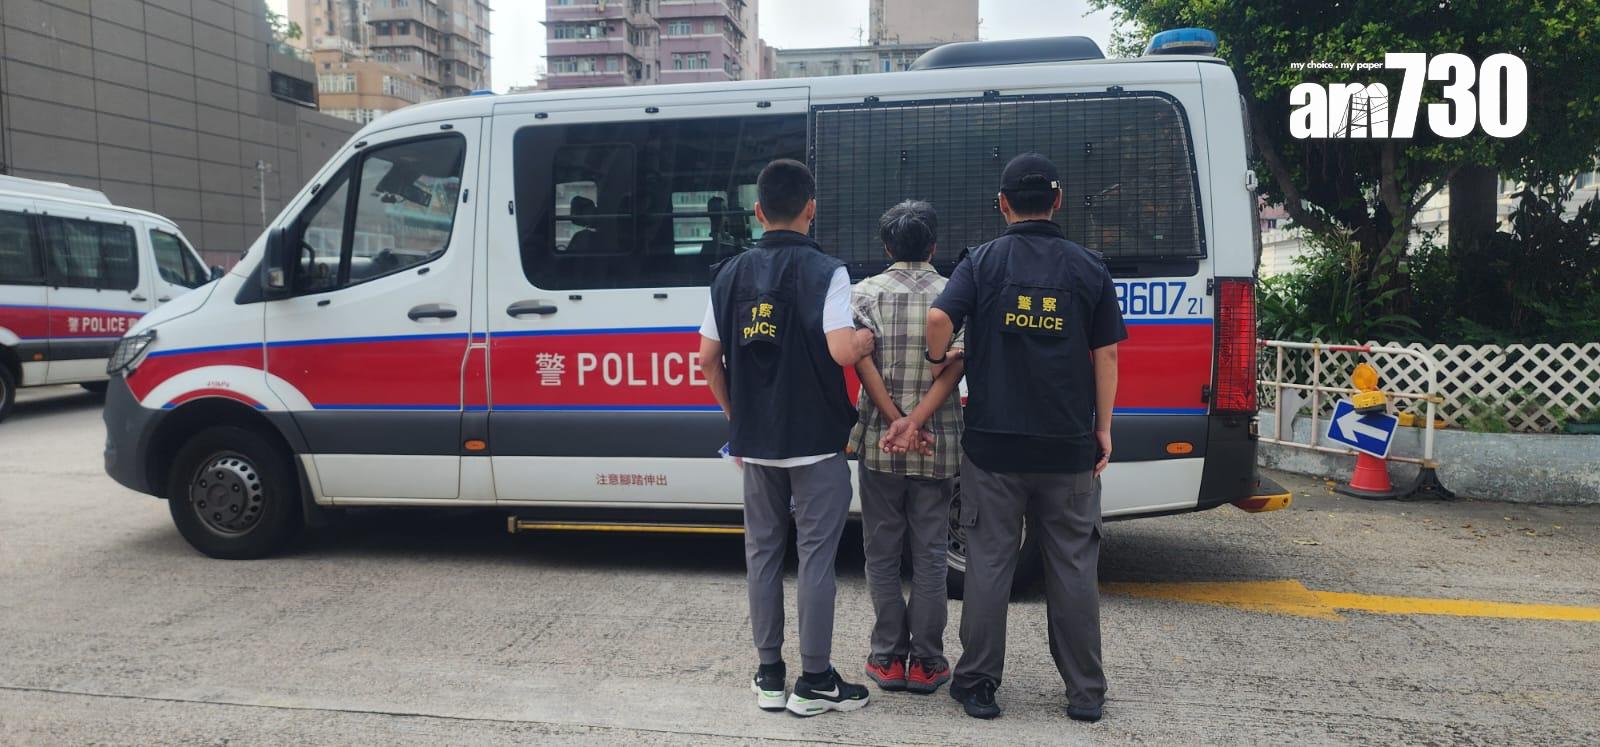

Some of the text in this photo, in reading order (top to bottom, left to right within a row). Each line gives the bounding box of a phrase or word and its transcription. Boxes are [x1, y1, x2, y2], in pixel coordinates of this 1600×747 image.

[82, 316, 126, 333] POLICE
[743, 321, 777, 339] PICE
[1005, 312, 1064, 331] POLICE
[535, 352, 708, 387] 警 POLICE
